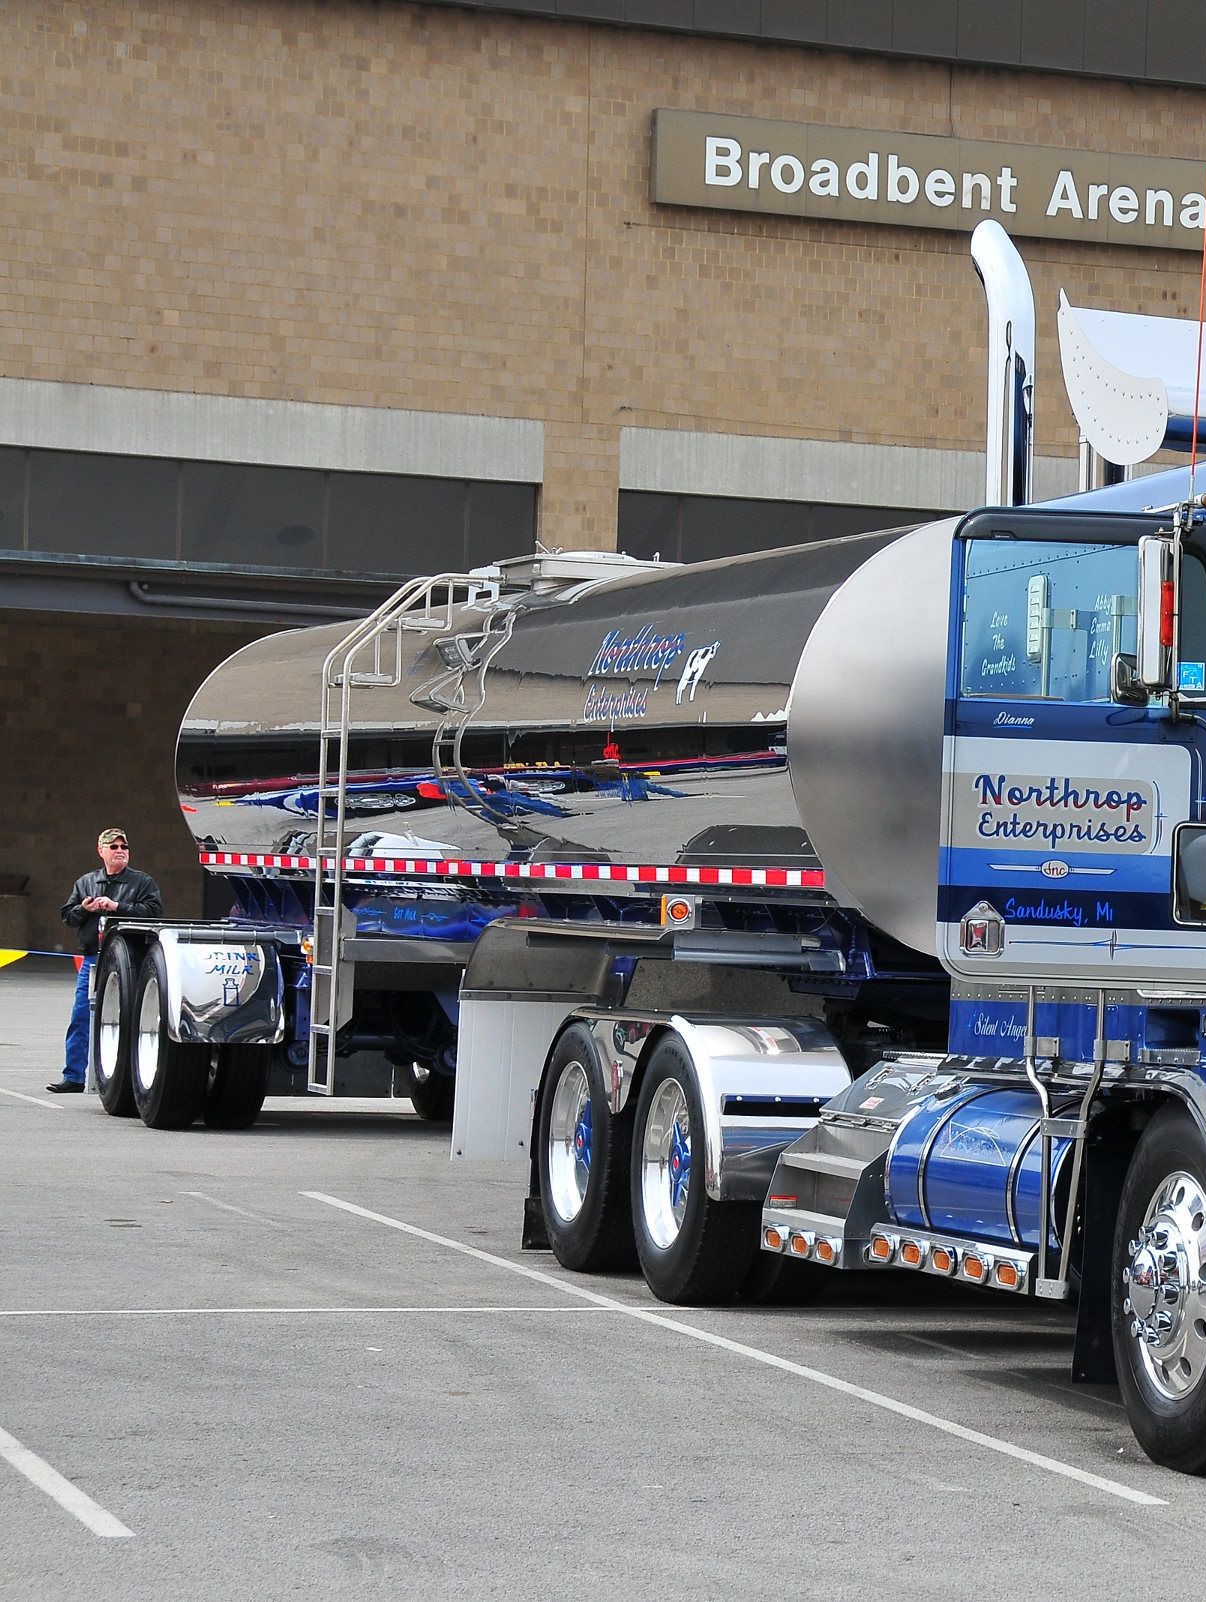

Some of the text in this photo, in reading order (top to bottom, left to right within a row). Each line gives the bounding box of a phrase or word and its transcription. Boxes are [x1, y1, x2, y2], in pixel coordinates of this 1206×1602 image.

[704, 136, 1017, 214] Broadbent
[990, 611, 1008, 628] Love
[1090, 617, 1111, 634] Emma
[992, 633, 1005, 651] The
[588, 624, 685, 691] Northrop
[993, 711, 1035, 725] Dianna
[974, 774, 1148, 823] Northrop
[978, 811, 1147, 849] Enterprises
[205, 964, 254, 975] MILK
